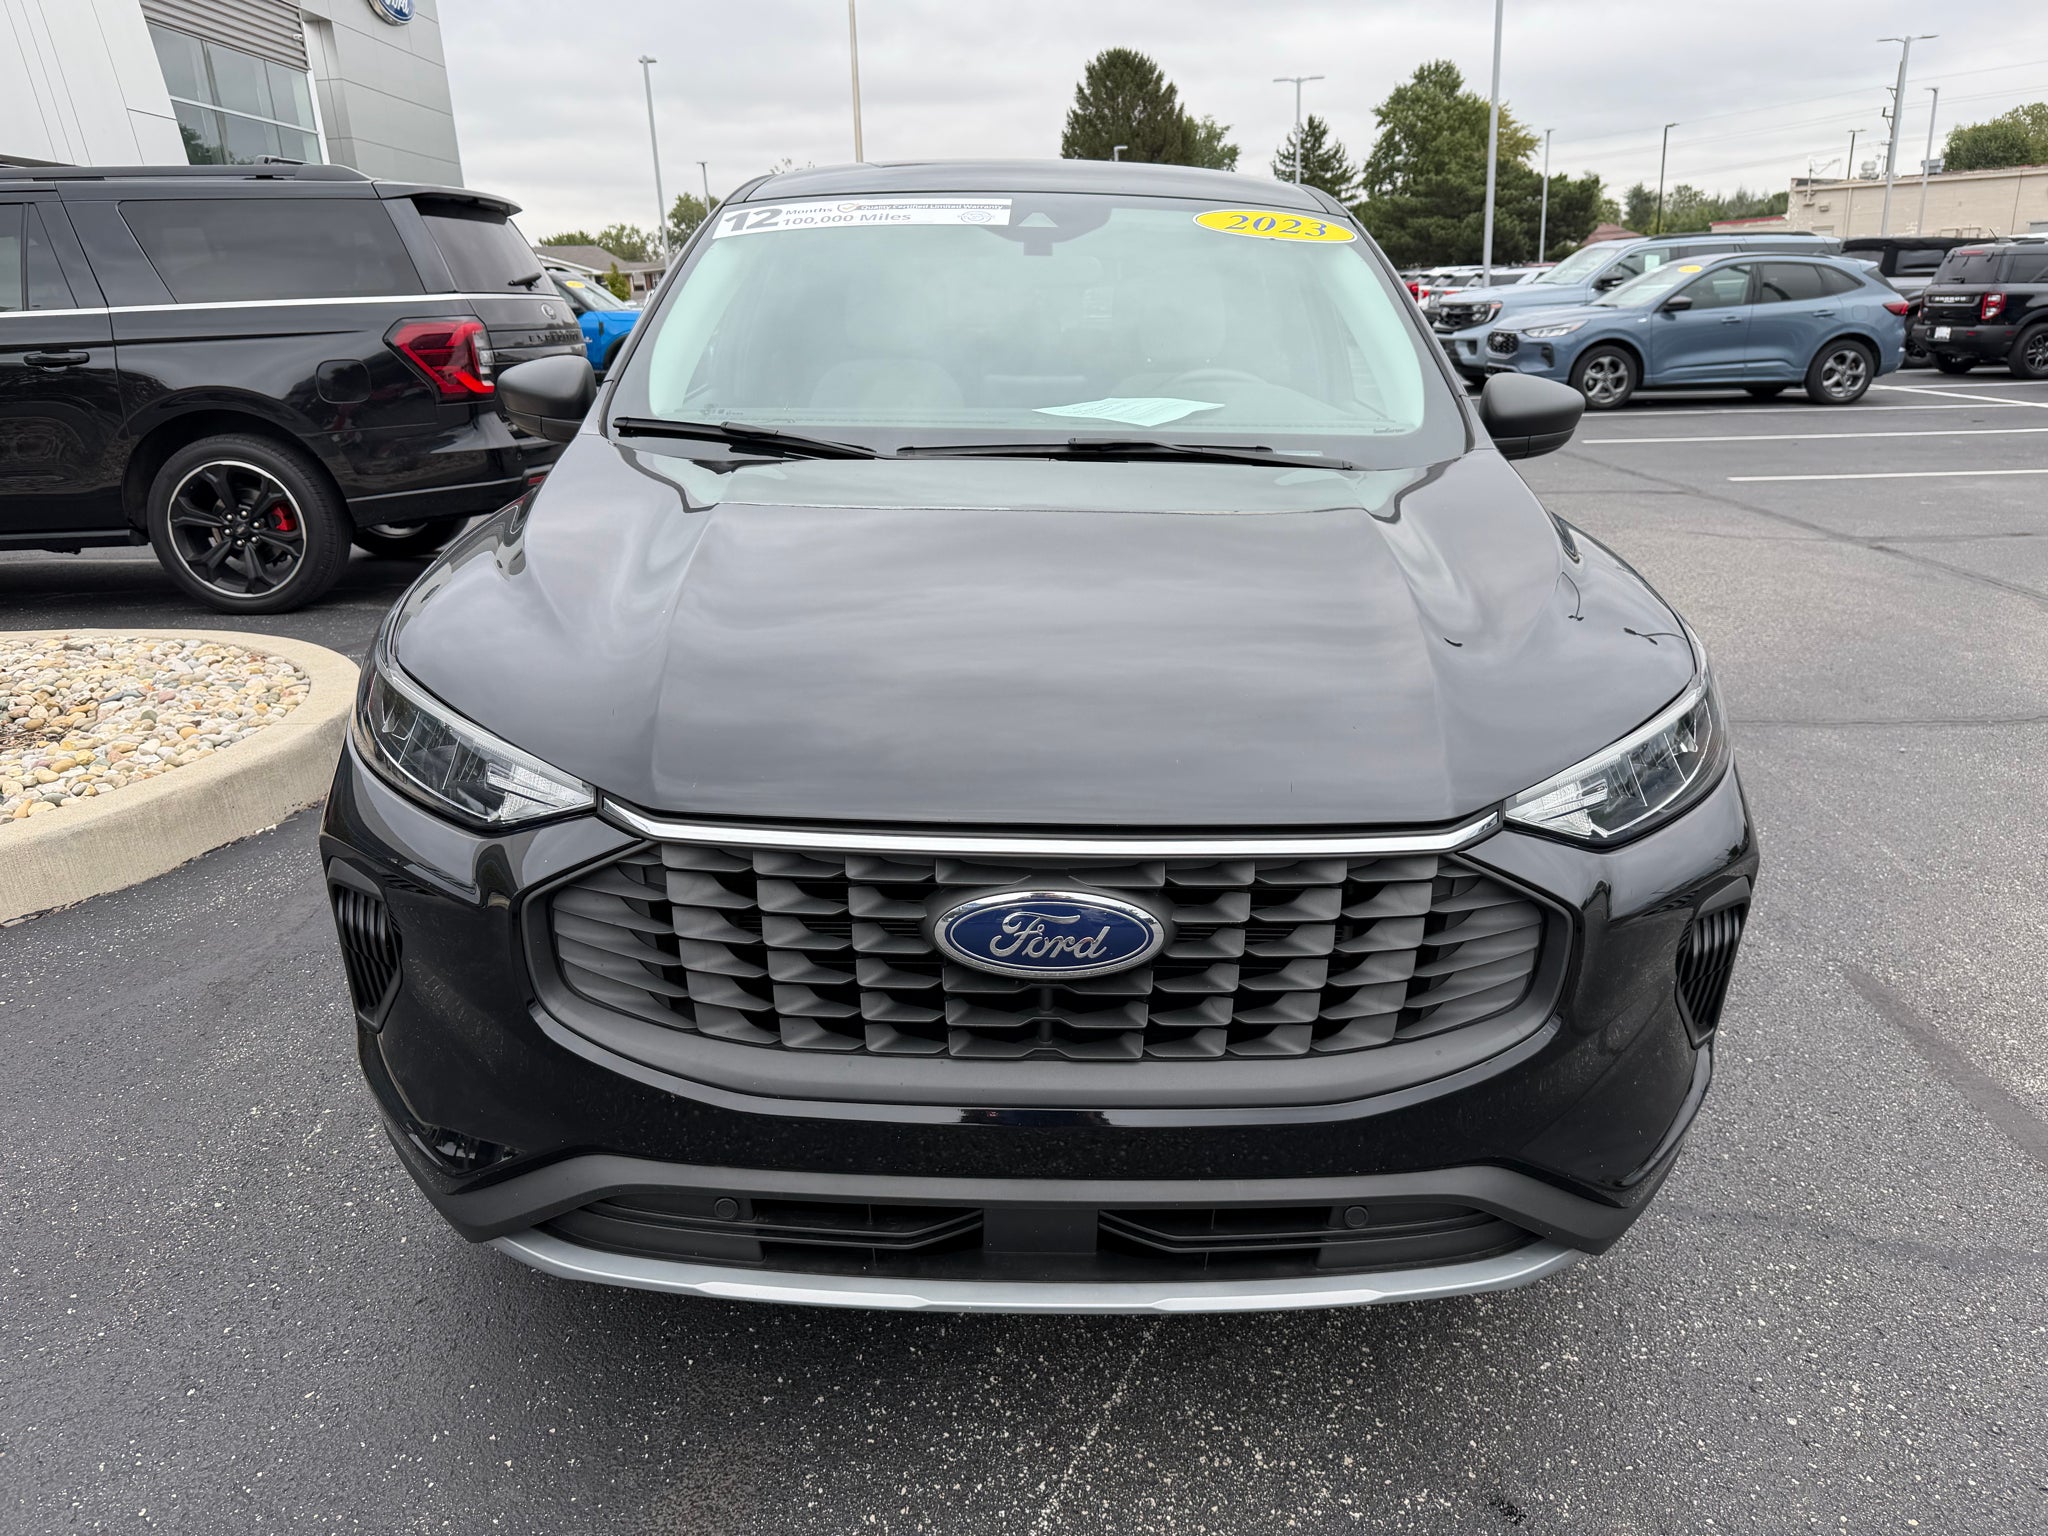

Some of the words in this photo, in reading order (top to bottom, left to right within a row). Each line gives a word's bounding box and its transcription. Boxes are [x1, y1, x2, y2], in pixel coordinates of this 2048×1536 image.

[725, 208, 783, 232] 12
[782, 215, 854, 226] 100,000
[859, 213, 912, 222] Miles
[785, 207, 833, 215] Months
[1224, 214, 1327, 237] 2023
[989, 911, 1111, 959] Ford
